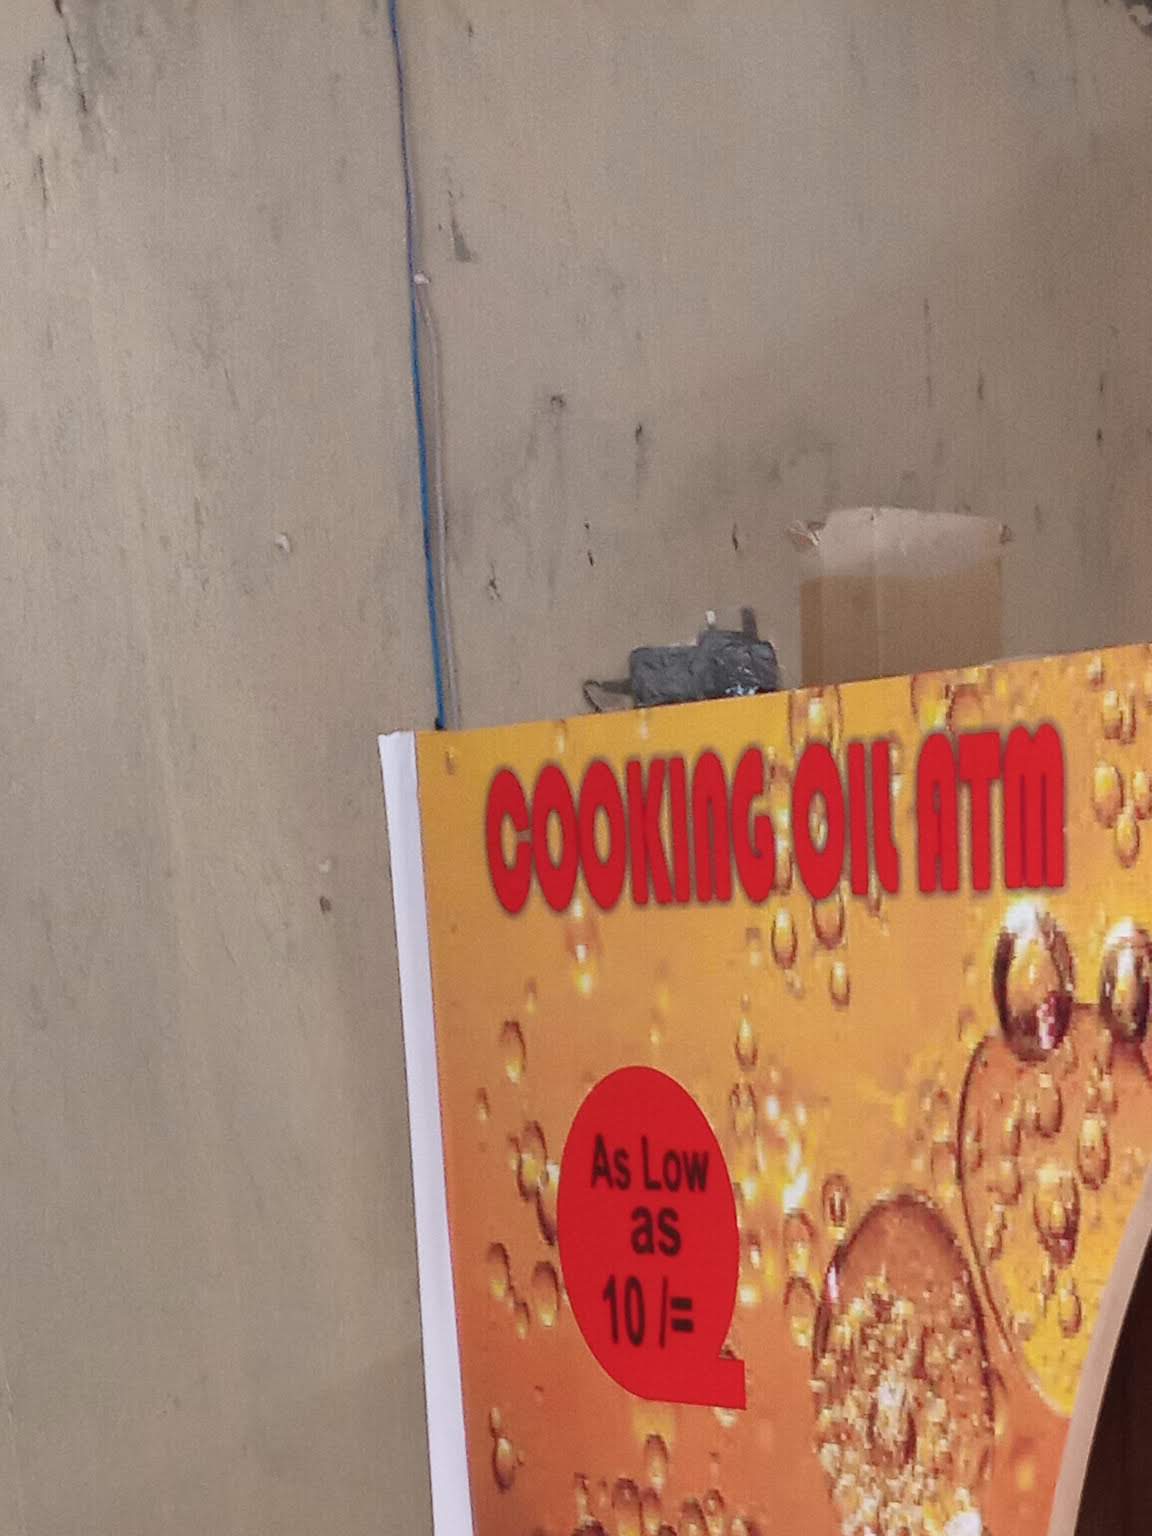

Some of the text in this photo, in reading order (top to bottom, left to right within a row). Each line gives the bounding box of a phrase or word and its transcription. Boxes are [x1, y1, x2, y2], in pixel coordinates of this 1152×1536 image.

[486, 722, 1066, 915] COOKING OIL ATM
[590, 1133, 709, 1192] As Low
[630, 1207, 682, 1256] as
[602, 1276, 646, 1347] 10
